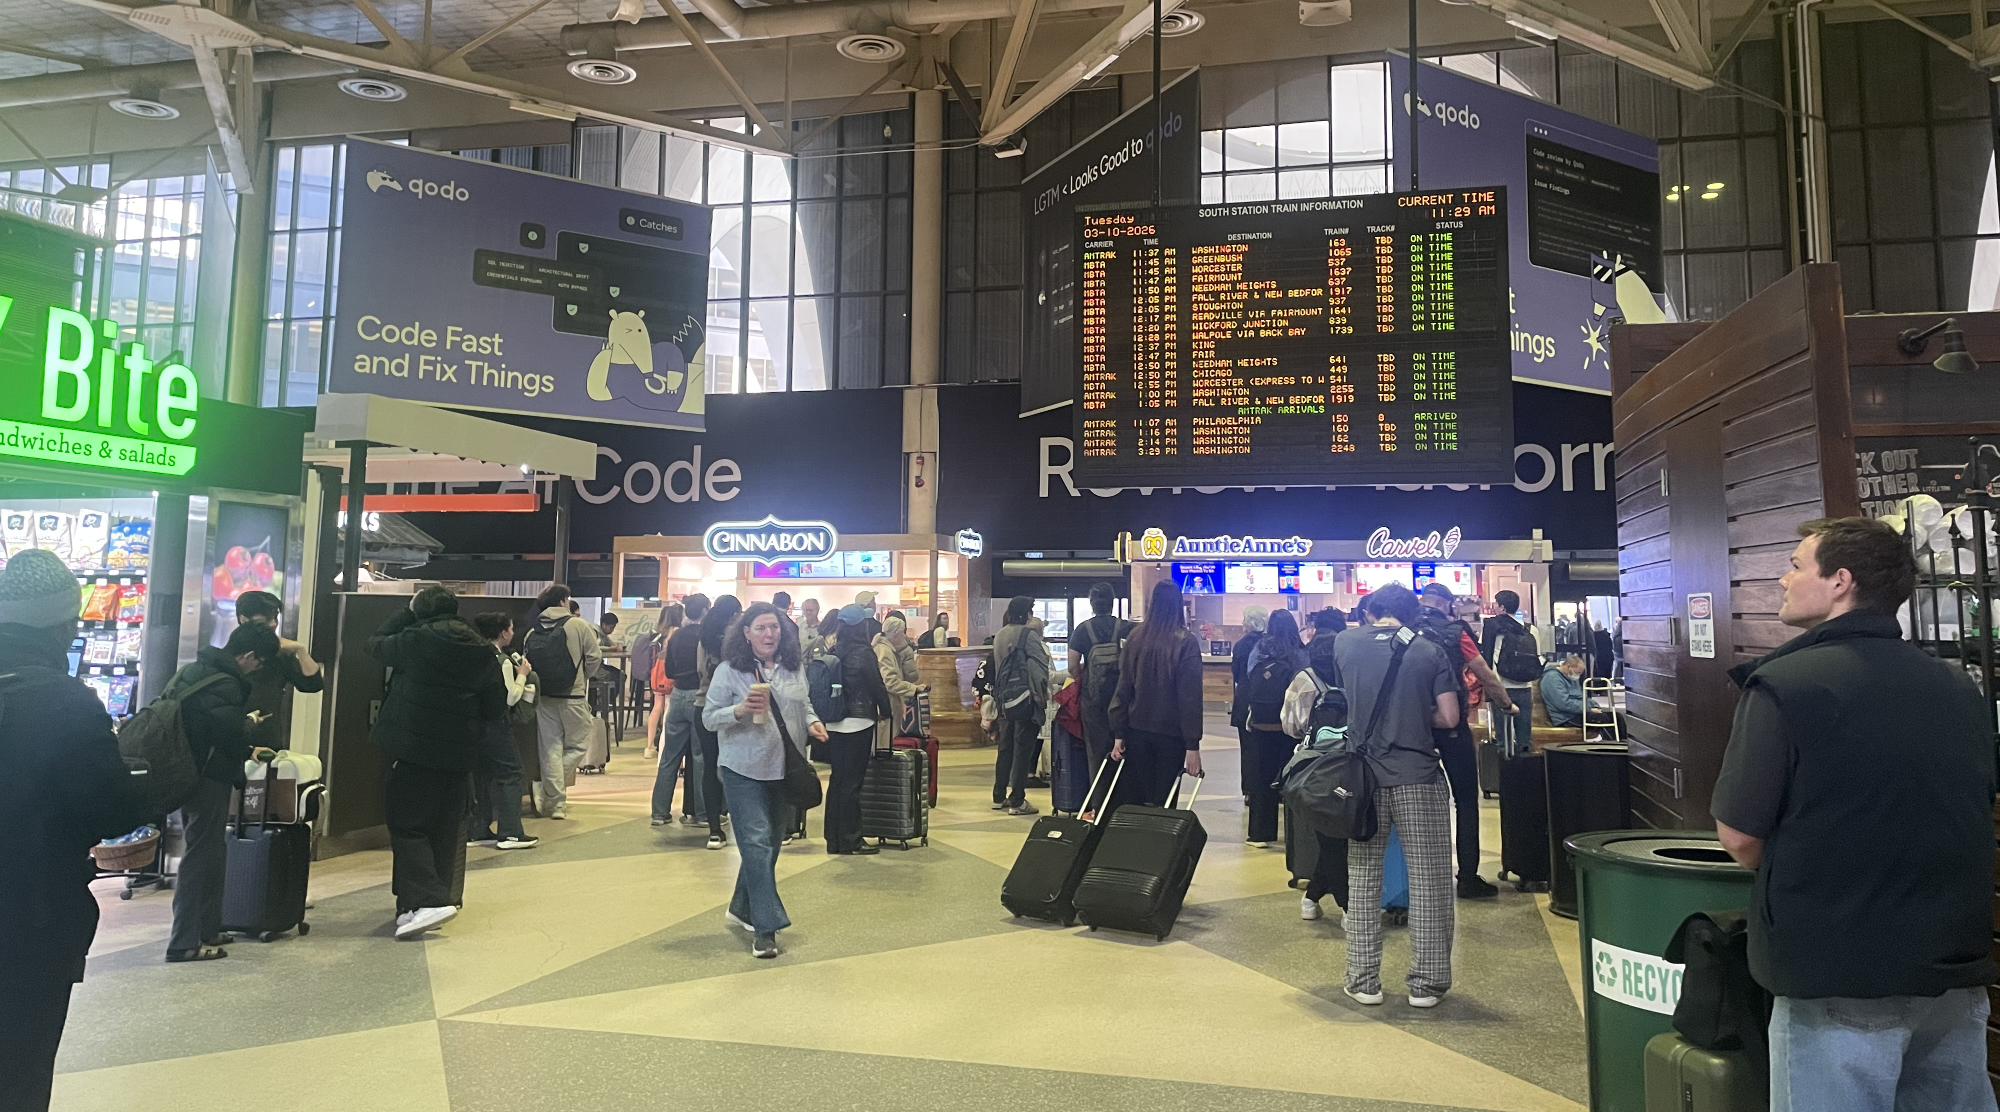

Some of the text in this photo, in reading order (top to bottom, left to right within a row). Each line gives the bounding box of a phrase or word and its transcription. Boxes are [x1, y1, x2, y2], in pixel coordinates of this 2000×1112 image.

[1435, 102, 1480, 129] qodo
[1034, 184, 1060, 216] LGTM
[1070, 165, 1098, 194] Looks
[1100, 141, 1129, 176] Good
[1131, 138, 1143, 158] to
[408, 178, 469, 202] qodo
[1398, 191, 1495, 207] CURRENT TIME
[1085, 215, 1135, 226] Tuesday
[1199, 200, 1364, 217] SOUTH STATION TRAIN INFORMATION
[1432, 206, 1495, 218] 11:29 AM
[639, 218, 678, 234] Catches
[1084, 226, 1155, 238] 03-10-2026
[1084, 221, 1464, 248] CARRIER TIME DESTINATION TRAIN# TRACK# STATUS
[1084, 233, 1452, 259] AMTRAK 11:37 AM WASHINGTON 163 TBD ON TIME
[1084, 242, 1452, 269] MBTA 11:45 AM GREENBUSH 1065 TBD ON TIME
[1083, 279, 1105, 287] MBTA
[1133, 276, 1159, 285] 11:47
[1164, 276, 1176, 284] AM
[1192, 272, 1242, 283] FAIRMOUNT
[1330, 267, 1351, 276] 1637
[1376, 265, 1393, 274] TBD
[1430, 262, 1452, 270] TIME
[1084, 288, 1105, 297] MBTA
[1134, 286, 1159, 295] 11:50
[1164, 285, 1176, 293] AM
[1192, 283, 1231, 292] NEEDHAM
[1236, 281, 1276, 290] HEIGHTS
[1328, 277, 1346, 286] 637
[1376, 275, 1393, 283] TBD
[1431, 272, 1453, 280] TIME
[1083, 292, 1453, 316] MBTA 12:05 PM STOUGHTON 937 TBD ON TIME
[1083, 316, 1105, 325] MBTA
[1133, 314, 1159, 322] 12:17
[1192, 311, 1242, 320] READVILLE
[1248, 310, 1265, 318] VIA
[1271, 308, 1321, 316] FAIRMOUNT
[1330, 306, 1350, 314] 1641
[1376, 304, 1394, 312] TBD
[1412, 303, 1424, 311] ON
[1431, 302, 1453, 310] TIME
[357, 315, 503, 356] Code Fast
[1083, 335, 1105, 343] MBTA
[1134, 333, 1159, 341] 12:28
[1164, 332, 1176, 340] PM
[1192, 330, 1231, 339] WALPOLE
[1260, 329, 1282, 337] BACK
[1288, 328, 1305, 336] BAY
[1330, 326, 1352, 334] 1739
[1377, 324, 1394, 332] TBD
[1412, 323, 1424, 331] ON
[1432, 322, 1454, 330] TIME
[1510, 323, 1556, 363] ings
[1084, 344, 1105, 353] MBTA
[1134, 342, 1159, 351] 12:37
[1192, 340, 1215, 349] KING
[41, 306, 198, 440] Bite
[354, 353, 554, 397] and Fix Things
[1084, 372, 1116, 380] AMTRAK
[1134, 371, 1160, 379] 12:50
[1165, 370, 1176, 378] PM
[1192, 369, 1232, 378] CHICAGO
[1330, 365, 1347, 373] 449
[1378, 364, 1395, 372] TBD
[1433, 362, 1455, 370] TIME
[1084, 412, 1456, 428] AMTRAK 11:07 AM PHILADELPHIA 150 8 ARRIVED
[1238, 405, 1324, 414] AMTRAK ARRIVALS
[98, 441, 114, 458] &
[119, 444, 176, 467] salads
[1881, 449, 1918, 472] OUT
[574, 444, 742, 504] Code
[1858, 472, 1920, 499] OTHER
[712, 531, 824, 553] CINNABON
[1368, 529, 1435, 556] Carvel
